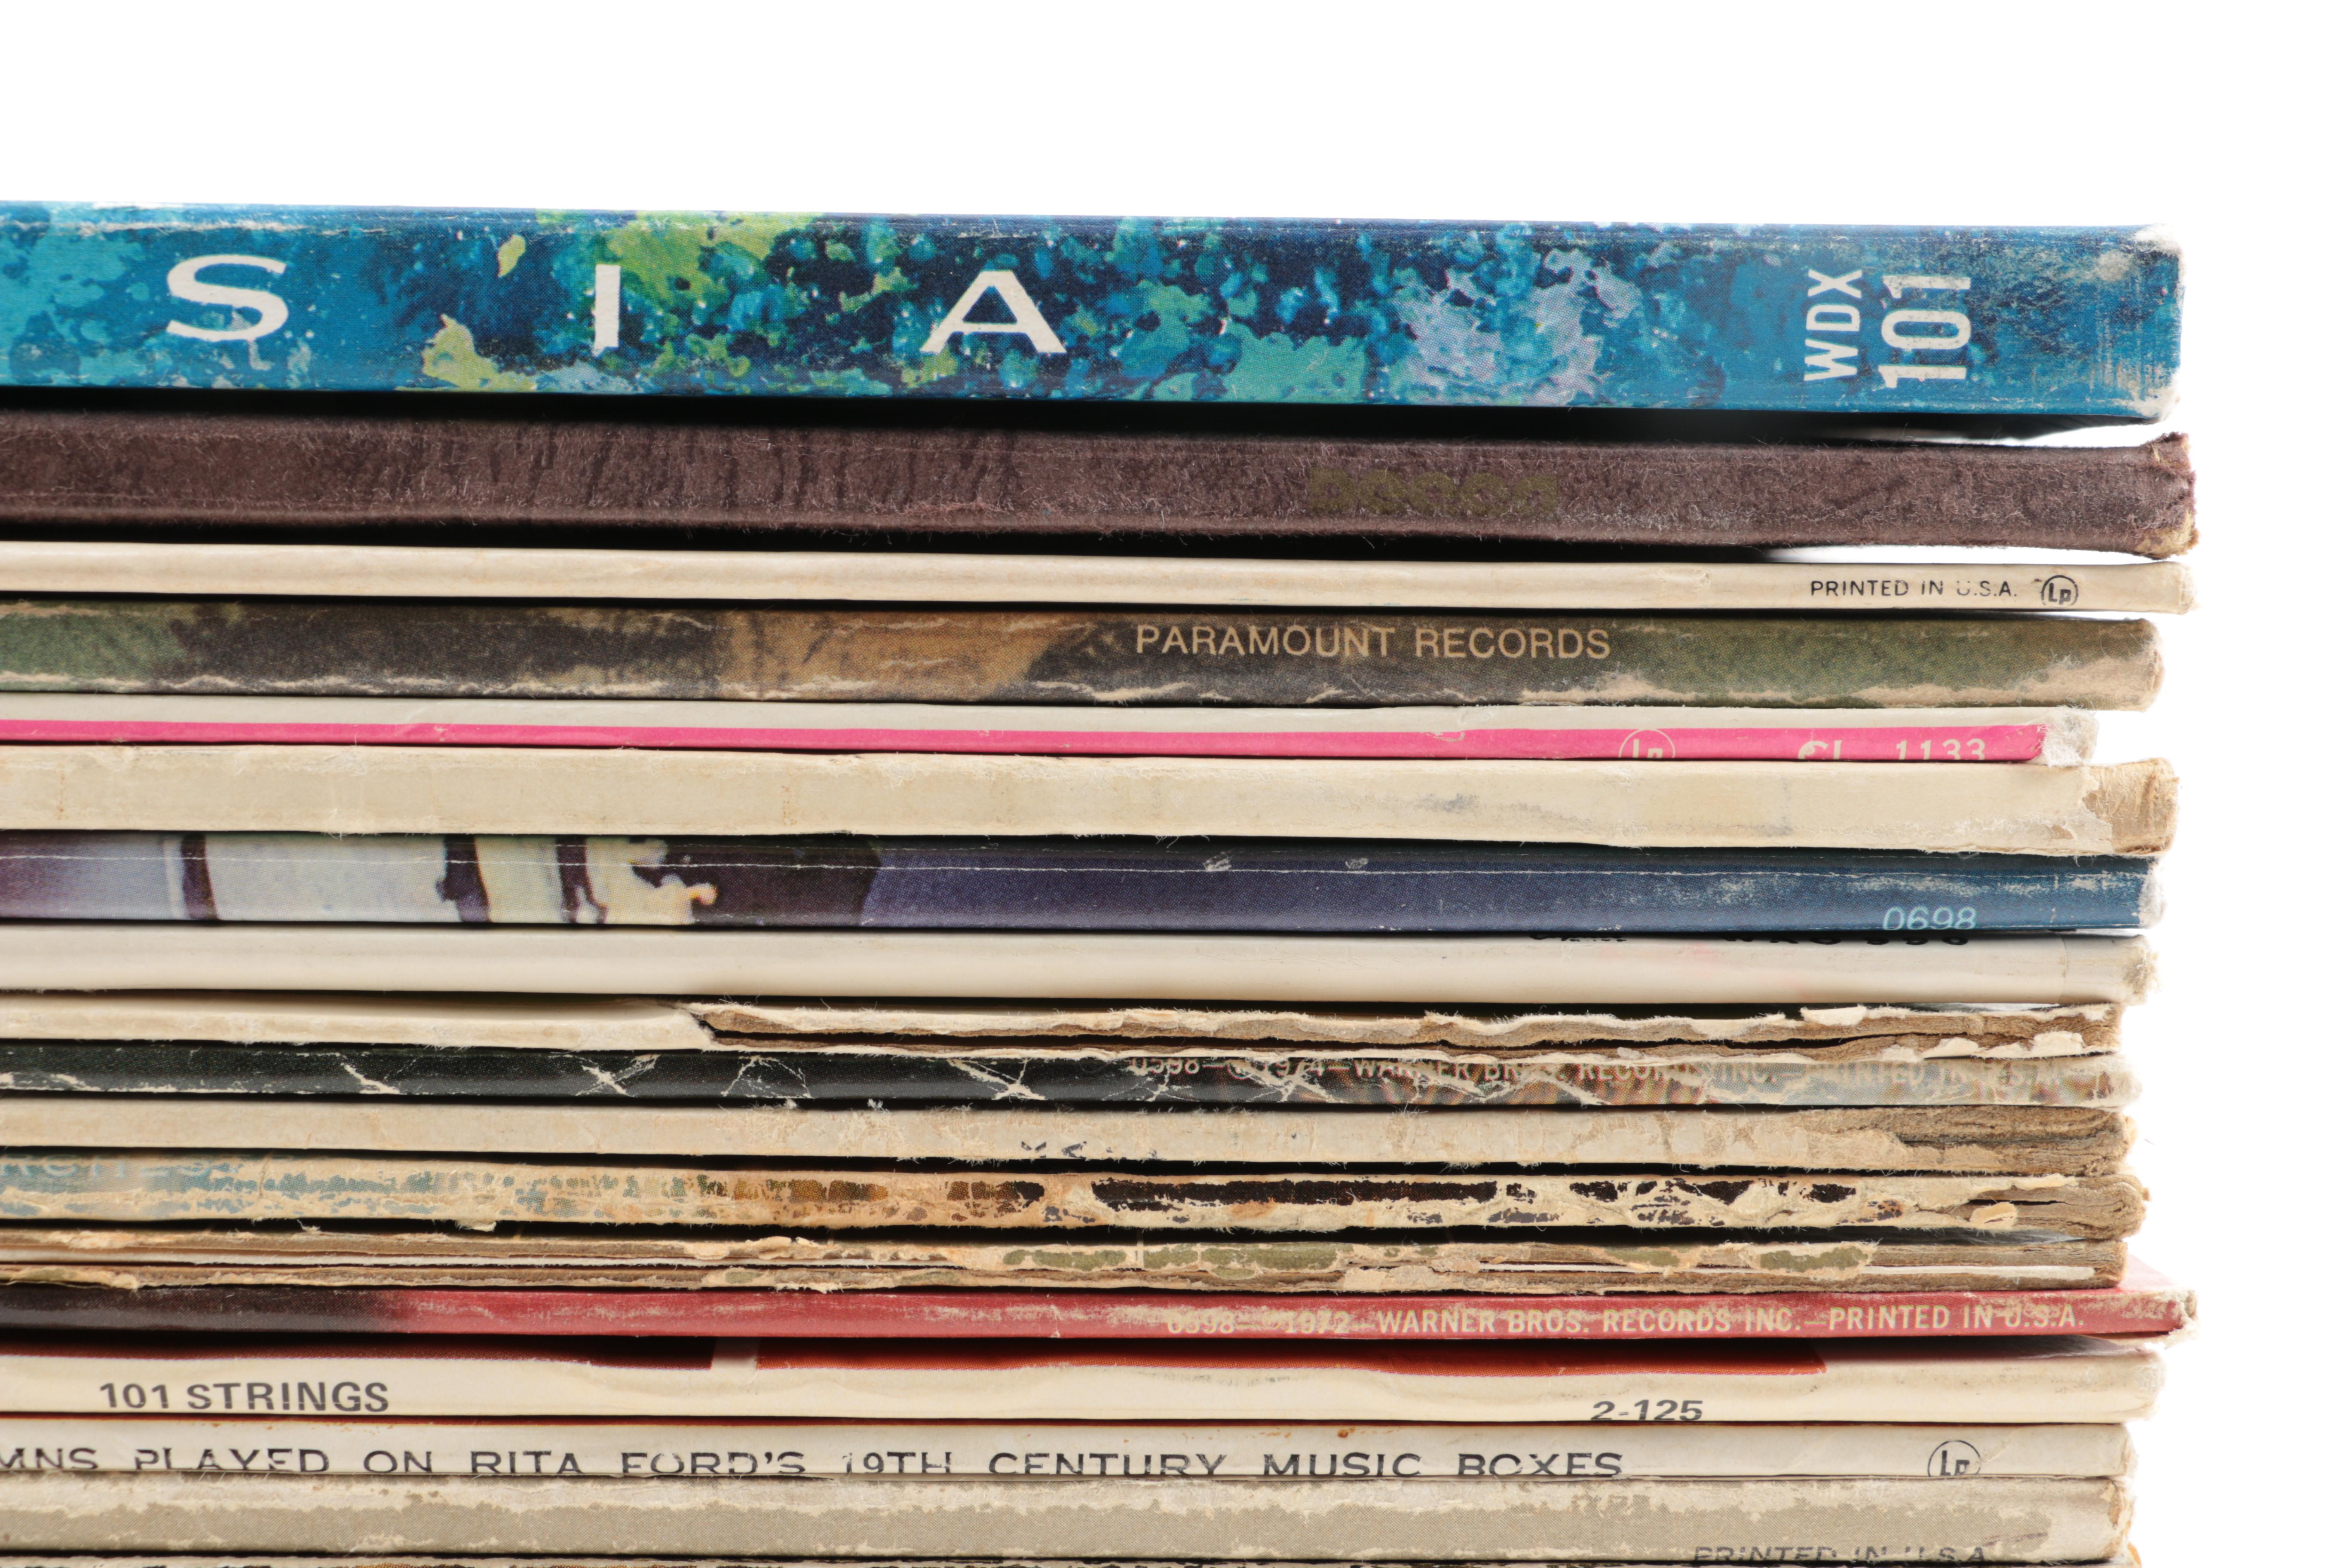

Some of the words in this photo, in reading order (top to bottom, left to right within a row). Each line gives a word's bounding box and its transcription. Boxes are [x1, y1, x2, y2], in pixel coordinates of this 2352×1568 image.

[1804, 269, 1862, 381] WDX
[1877, 275, 1971, 388] 101
[1810, 580, 1909, 596] PRINTED
[1921, 580, 1943, 595] IN
[1956, 580, 2017, 597] U.S.A.
[1136, 625, 1396, 658] PARAMOUNT
[1415, 628, 1611, 659] RECORDS
[1883, 906, 1976, 930] 0698
[1507, 1309, 1589, 1333] BROS.
[1602, 1308, 1731, 1332] RECORDS
[1963, 1304, 1992, 1328] IN
[2004, 1303, 2085, 1328] U.S.A.
[100, 1382, 169, 1409] 101
[187, 1382, 389, 1412] STRINGS
[1590, 1399, 1704, 1421] 2-125
[135, 1448, 330, 1473] PLAYED
[363, 1450, 432, 1473] ON
[471, 1450, 585, 1474] RITA
[621, 1451, 806, 1474] FORD'S
[843, 1451, 953, 1474] 19TH
[988, 1452, 1228, 1476] CENTURY
[1262, 1452, 1422, 1476] MUSIC
[1458, 1452, 1623, 1476] BOXES
